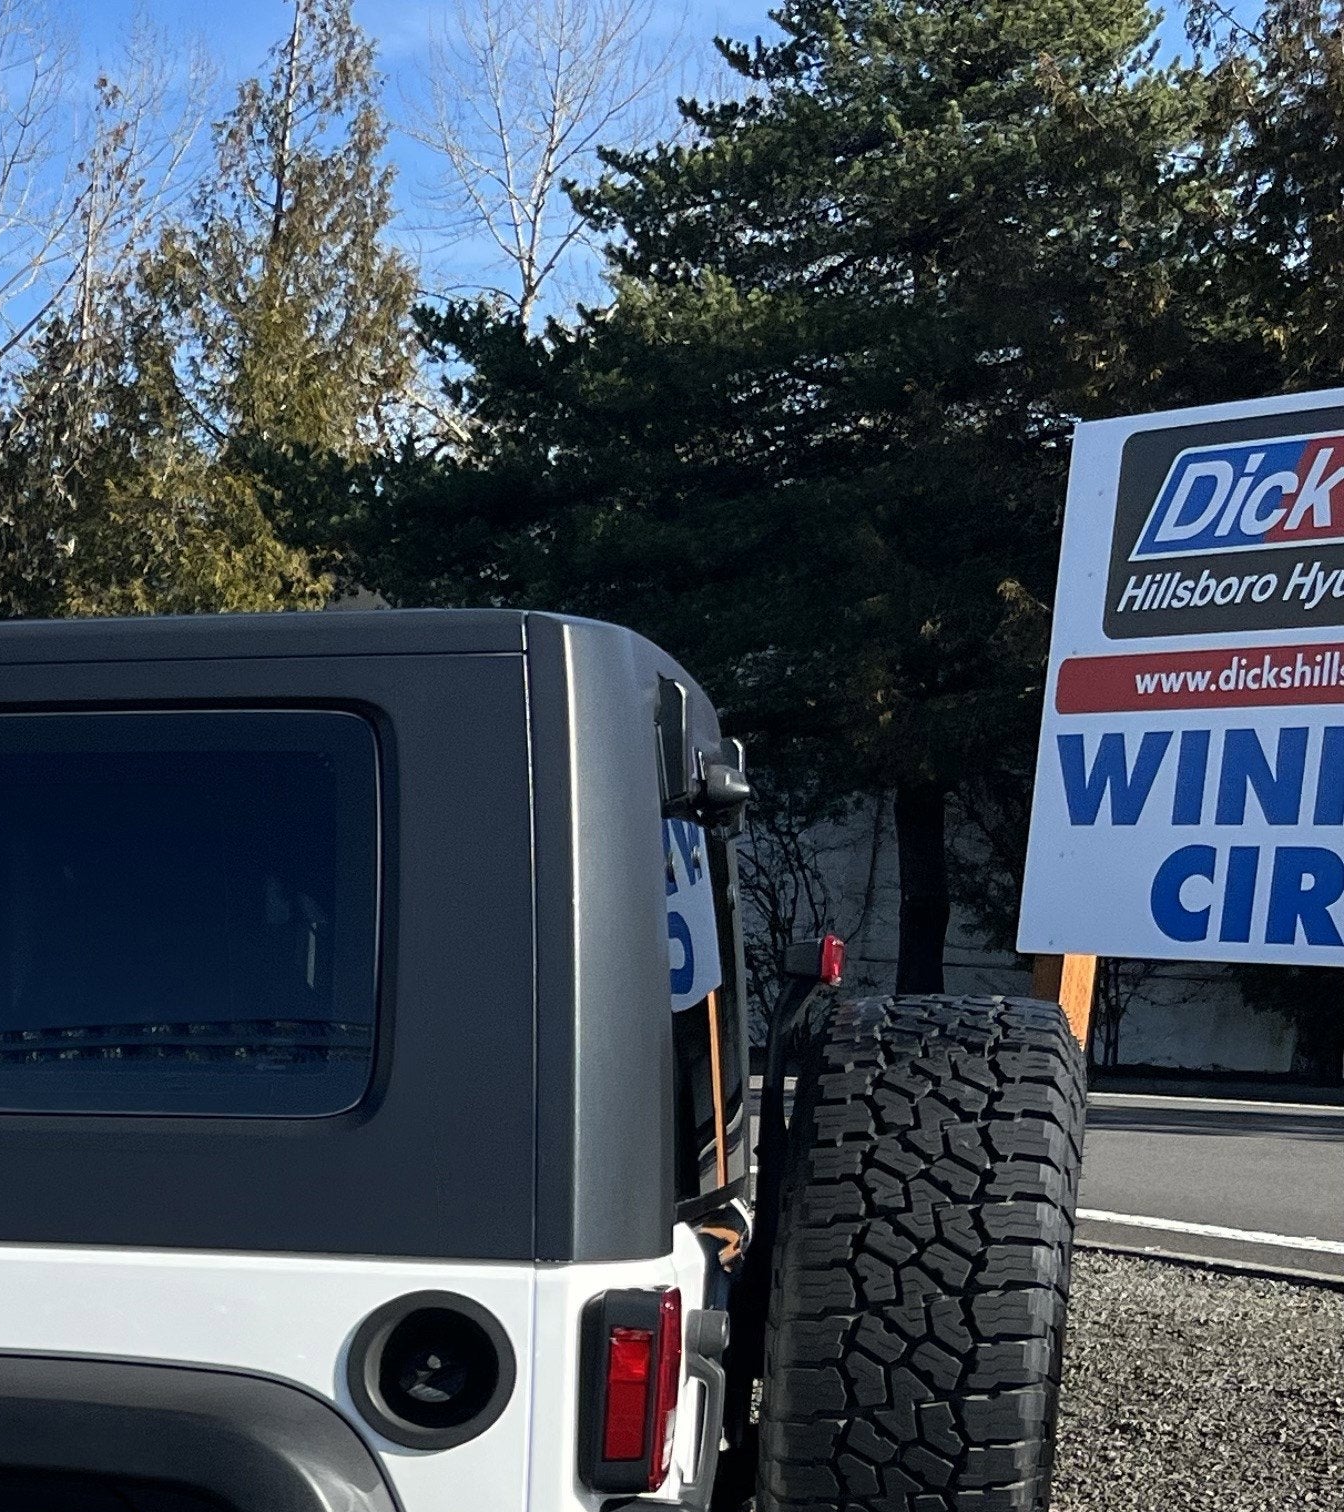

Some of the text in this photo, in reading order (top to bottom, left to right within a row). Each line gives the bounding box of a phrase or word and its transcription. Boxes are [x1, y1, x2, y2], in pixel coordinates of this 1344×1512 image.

[1154, 447, 1344, 542] Dick
[1117, 569, 1279, 612] Hillsboro
[1150, 844, 1344, 947] CIR
